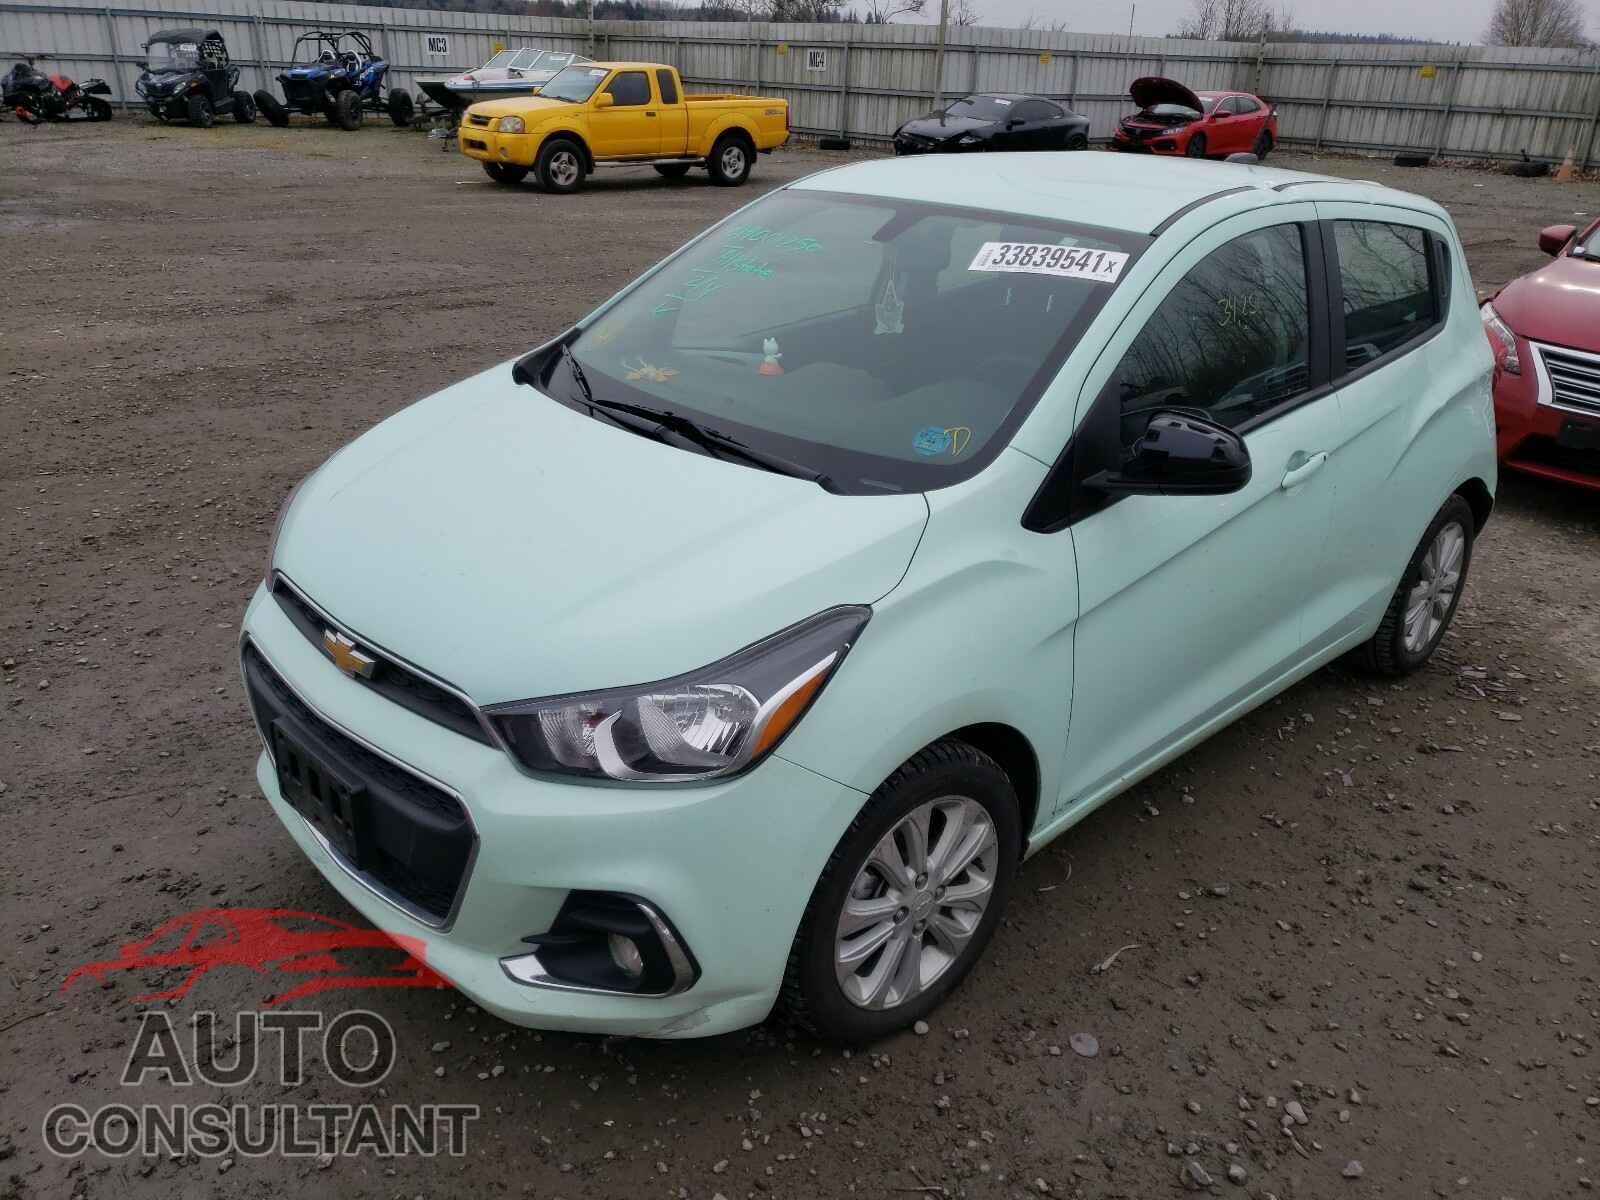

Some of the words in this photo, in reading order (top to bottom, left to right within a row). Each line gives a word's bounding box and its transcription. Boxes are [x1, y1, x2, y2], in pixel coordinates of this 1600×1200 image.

[428, 37, 447, 52] MC3
[809, 51, 824, 67] MC4
[993, 244, 1105, 273] 33839541
